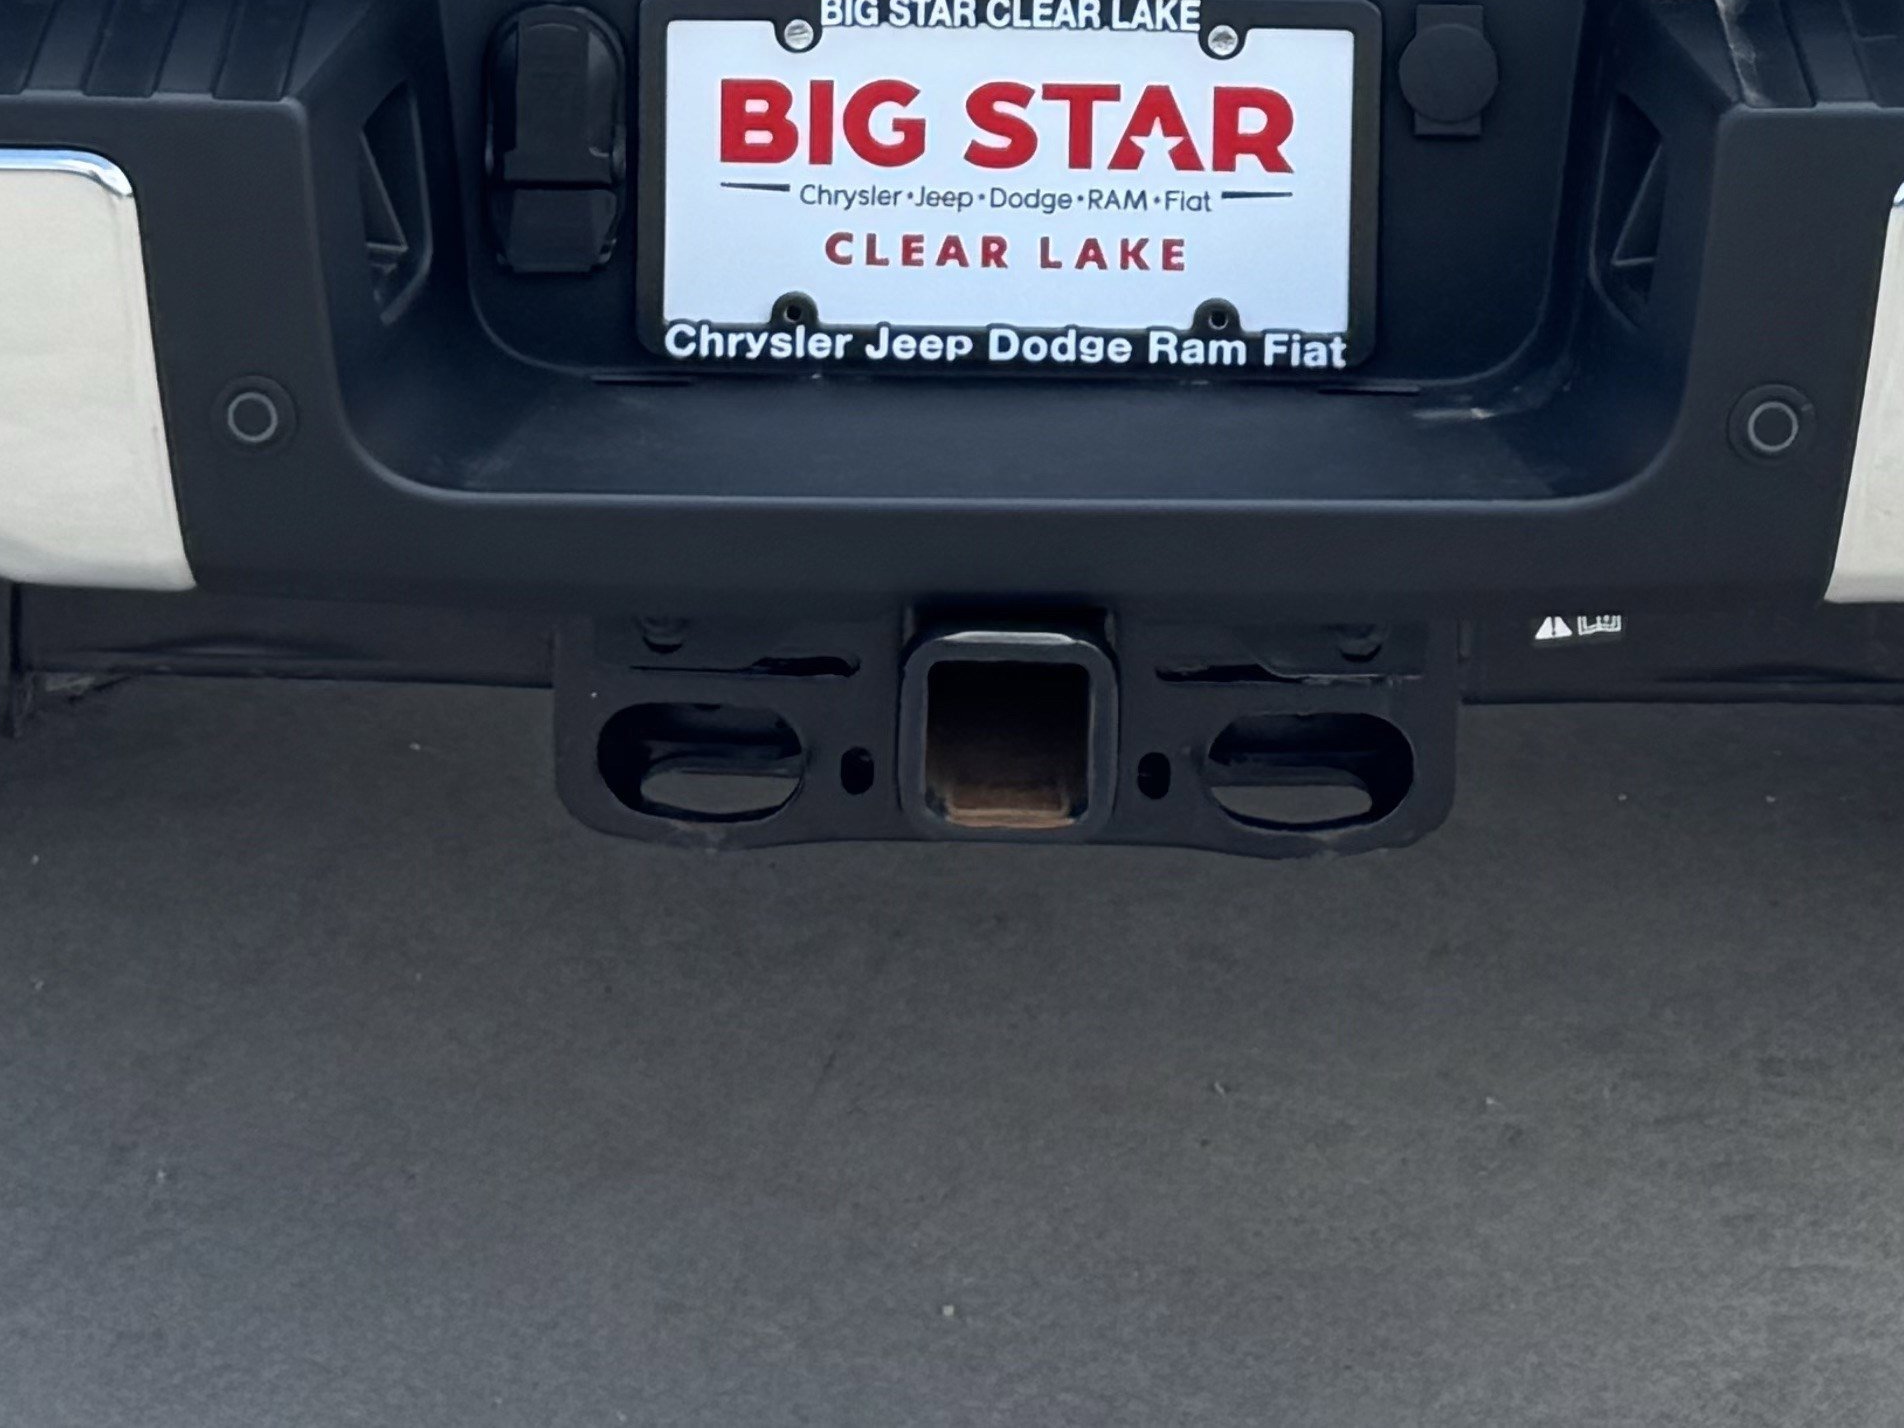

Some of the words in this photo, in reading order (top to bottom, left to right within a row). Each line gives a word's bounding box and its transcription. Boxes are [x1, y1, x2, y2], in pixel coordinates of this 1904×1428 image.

[720, 79, 926, 167] BIG
[966, 82, 1294, 173] STAR
[799, 183, 903, 211] Chrysler
[914, 185, 974, 213] Jeep
[989, 187, 1073, 215] Dodge
[1088, 188, 1148, 211] RAM
[1164, 189, 1213, 213] Fiat
[823, 231, 1010, 269] CLEAR
[1039, 235, 1187, 272] LAKE
[664, 323, 854, 360] Chrysler
[865, 326, 974, 361] Jeep
[988, 327, 1133, 363] Dodge
[1148, 330, 1247, 366] Ram
[1263, 332, 1347, 369] Fiat
